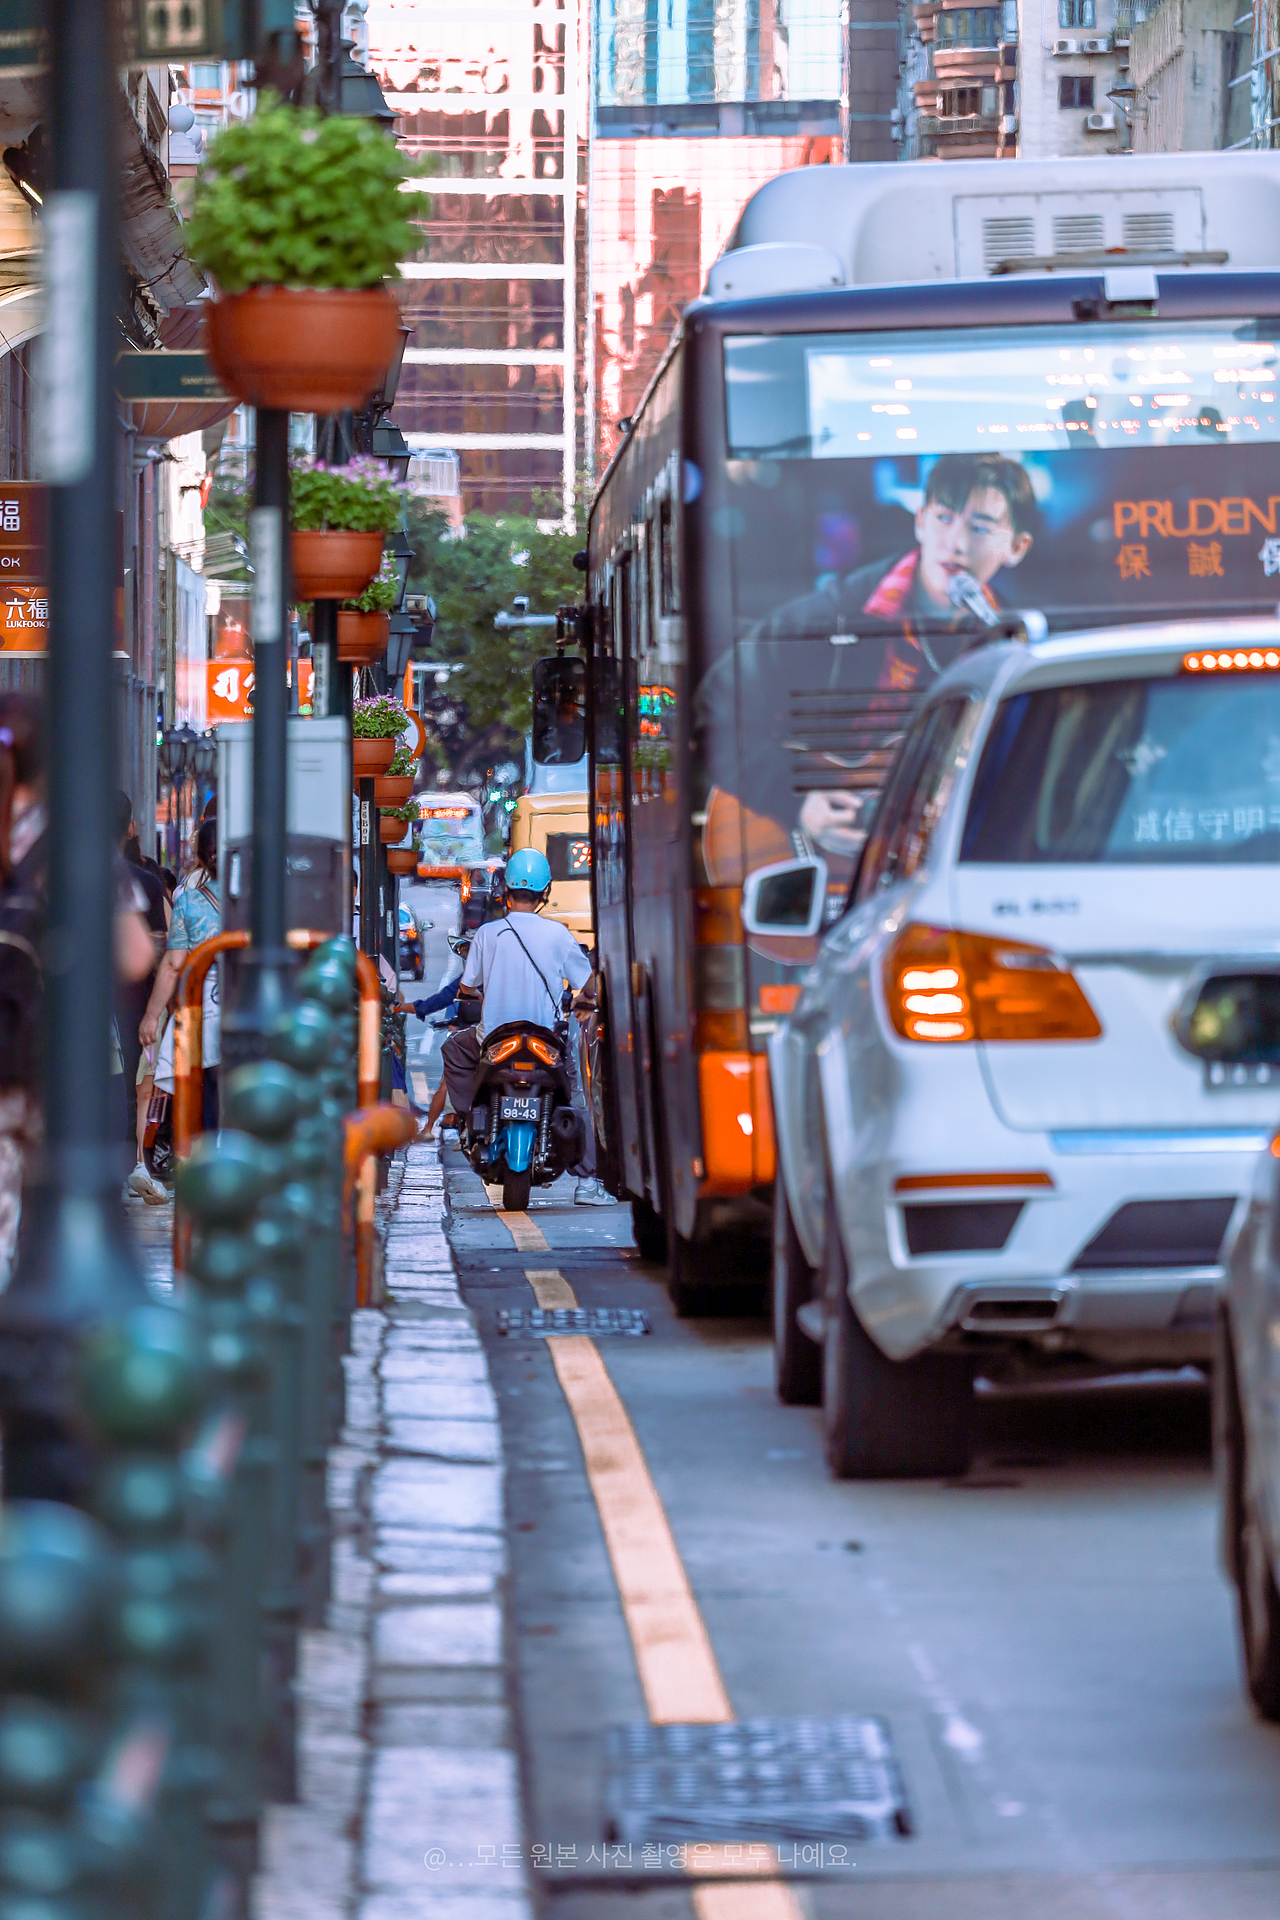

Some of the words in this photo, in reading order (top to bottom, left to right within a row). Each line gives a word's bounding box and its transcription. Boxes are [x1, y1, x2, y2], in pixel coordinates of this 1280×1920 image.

[5, 620, 46, 629] LUKFOOK
[513, 1098, 529, 1108] MU
[503, 1108, 537, 1119] 98-43
